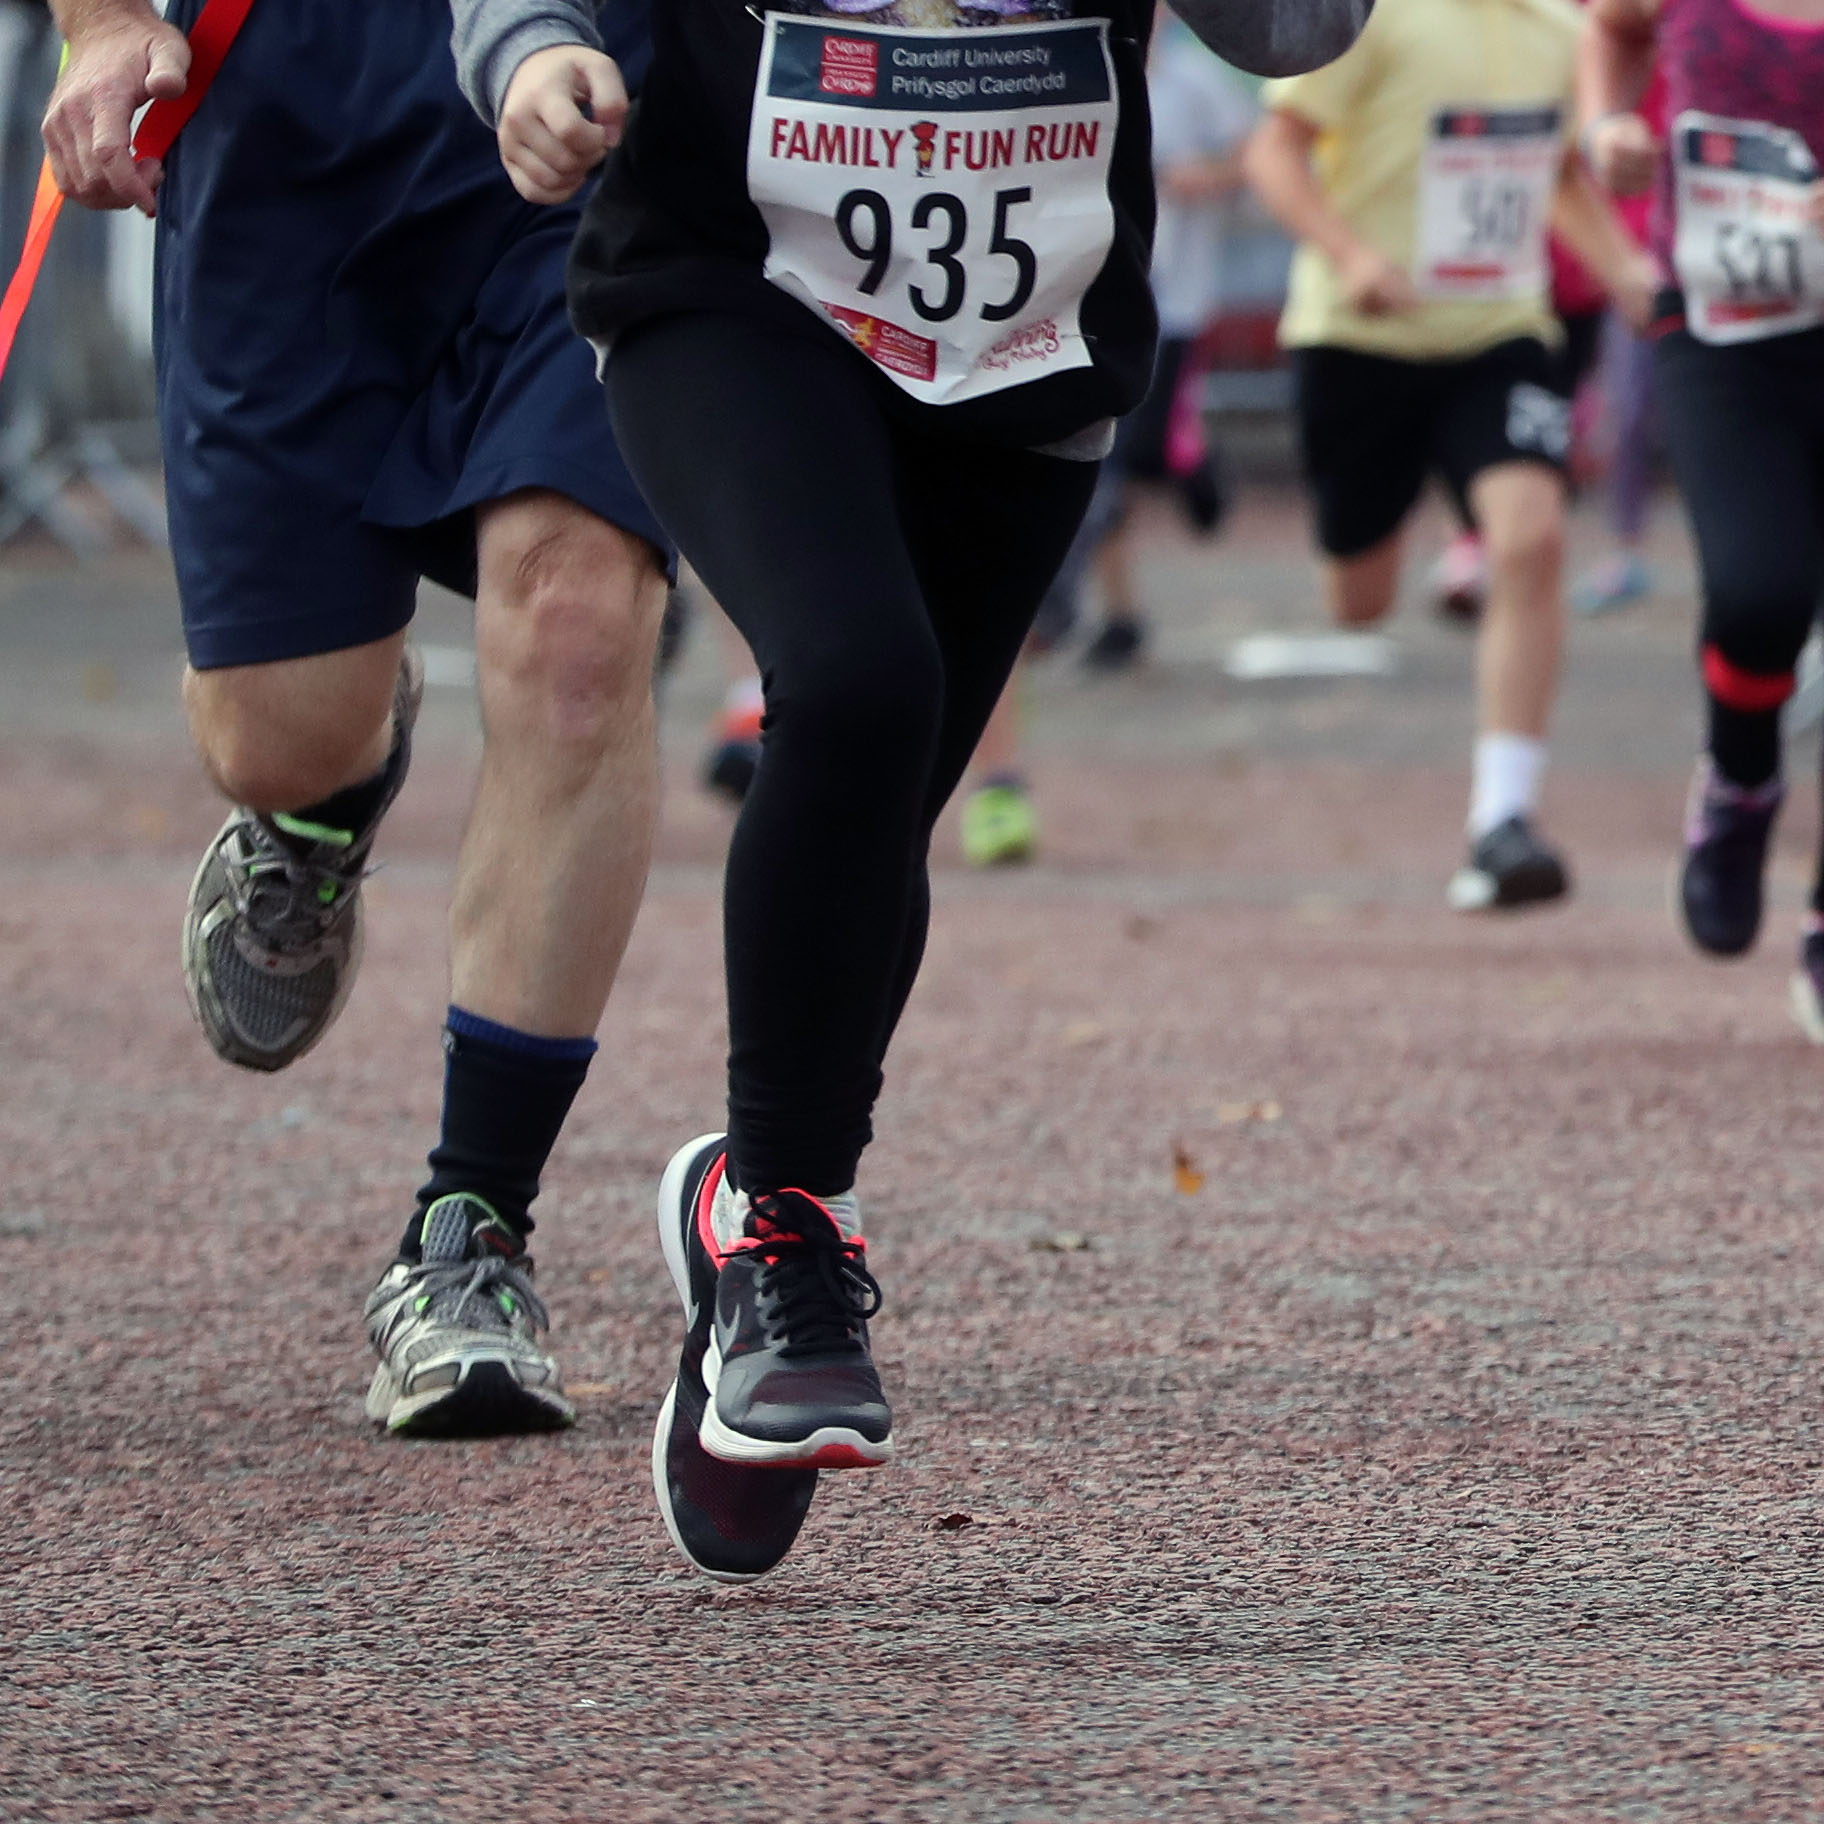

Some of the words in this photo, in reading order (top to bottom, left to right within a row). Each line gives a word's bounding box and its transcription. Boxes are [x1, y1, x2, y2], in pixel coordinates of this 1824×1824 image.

[892, 48, 962, 68] Cardiff
[964, 46, 1050, 68] University
[891, 76, 976, 100] Prifysgol
[979, 72, 1067, 95] Caerdydd
[769, 117, 905, 171] FAMILY
[943, 127, 1014, 171] FUN
[1025, 121, 1100, 164] RUN
[835, 186, 1038, 323] 935
